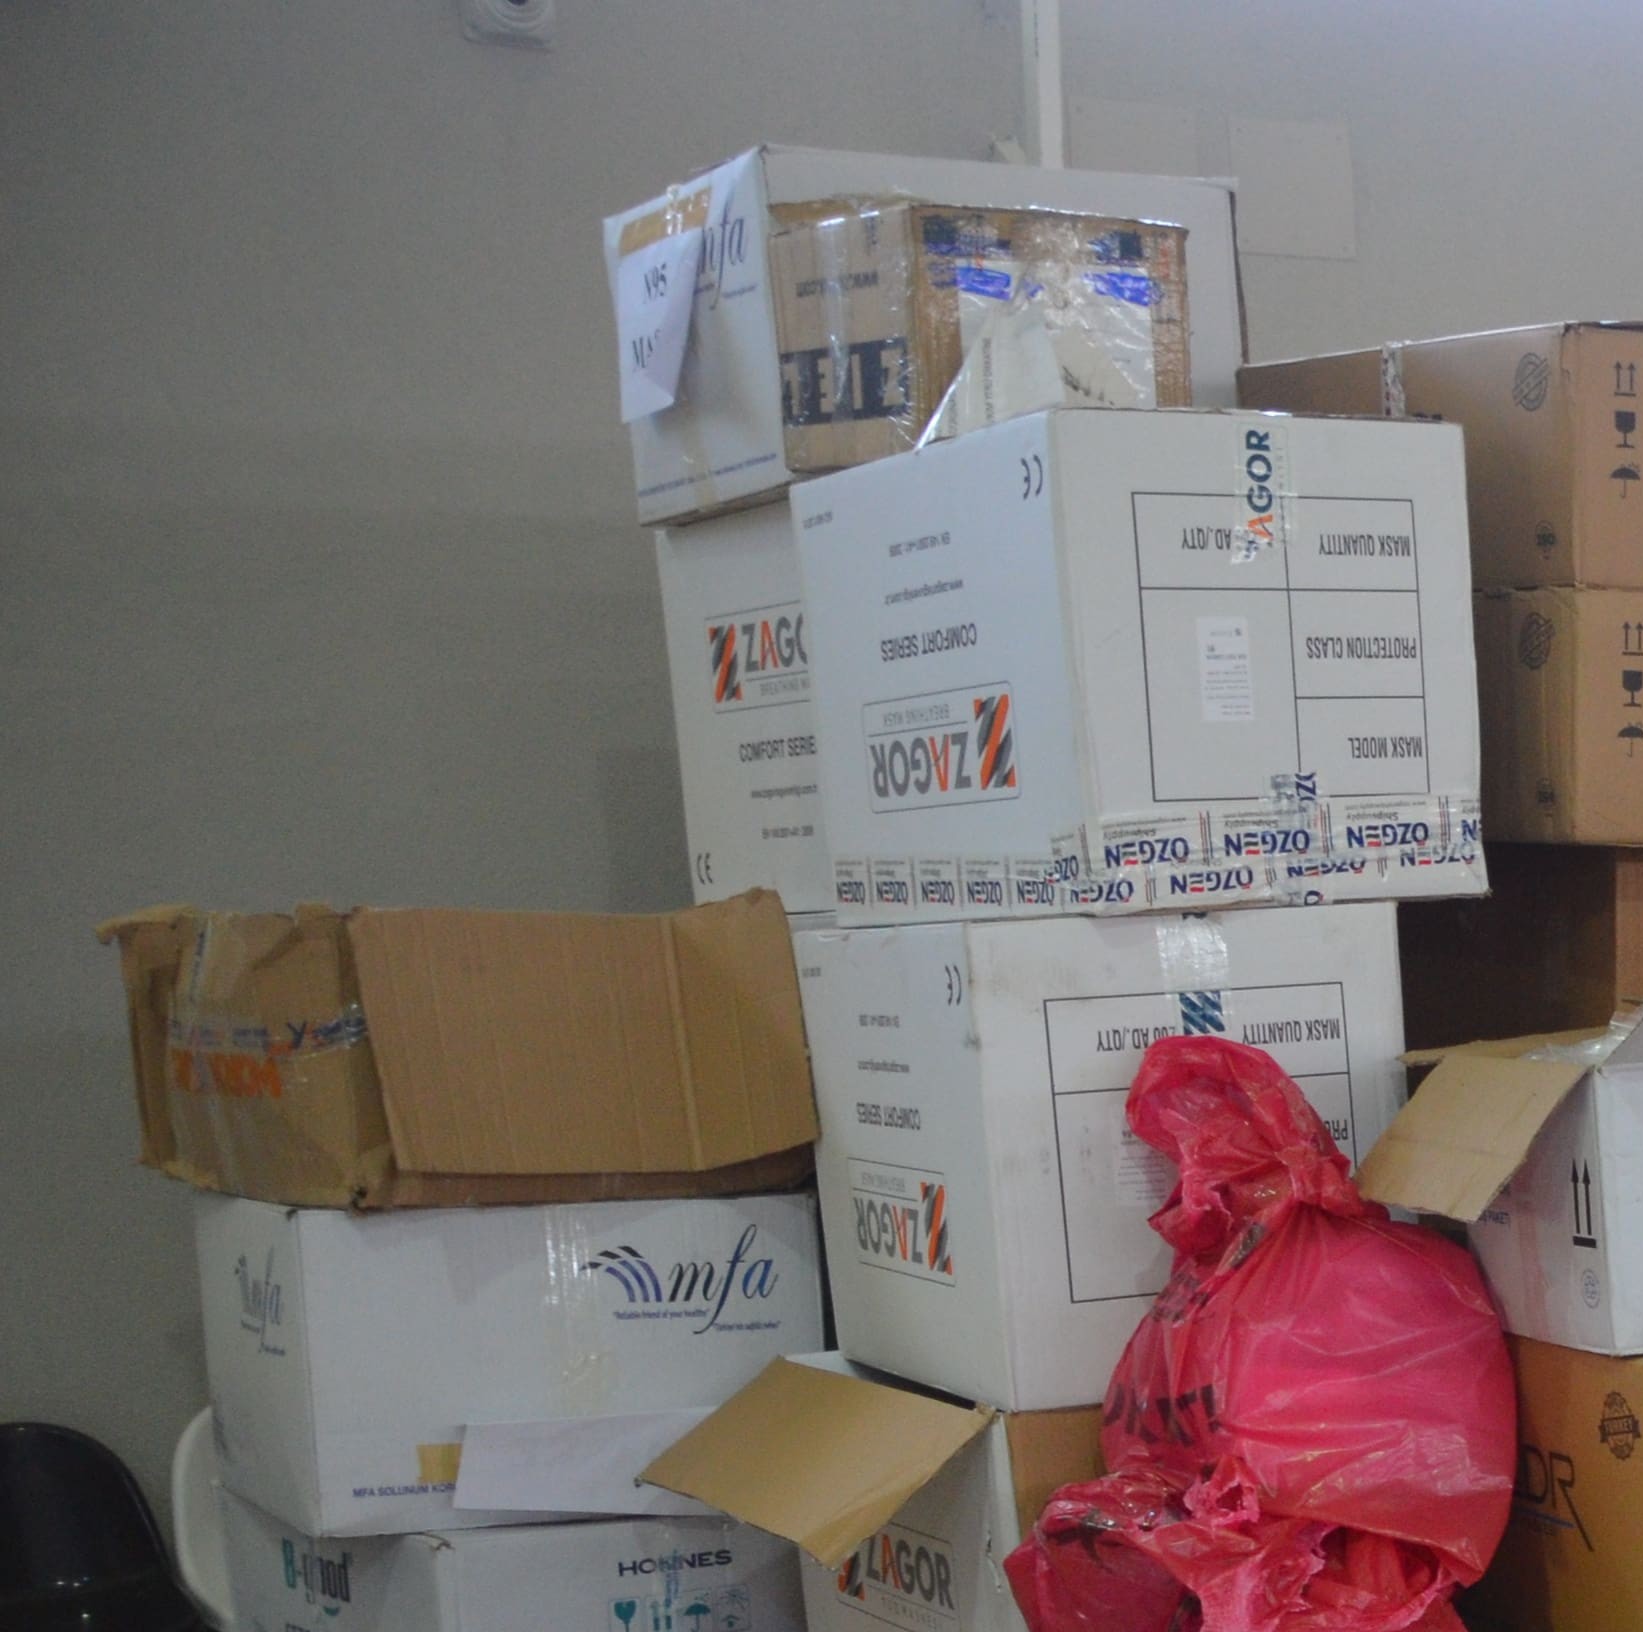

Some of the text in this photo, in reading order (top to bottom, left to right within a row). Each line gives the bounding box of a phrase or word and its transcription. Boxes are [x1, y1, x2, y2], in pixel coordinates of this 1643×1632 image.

[1318, 532, 1411, 557] MASK QUANTITY
[880, 621, 978, 663] COMFORT SERIES
[1305, 635, 1417, 660] PROTECTION CLASS
[738, 735, 818, 764] COMFORT SERIE
[1347, 735, 1424, 759] MASK MODEL
[868, 730, 973, 799] ZAGOR
[1241, 1017, 1341, 1045] MASK QUANTITY
[856, 1101, 921, 1131] COMFORT SERIES
[852, 1195, 923, 1264] ZAGOR
[668, 1223, 779, 1335] mfa
